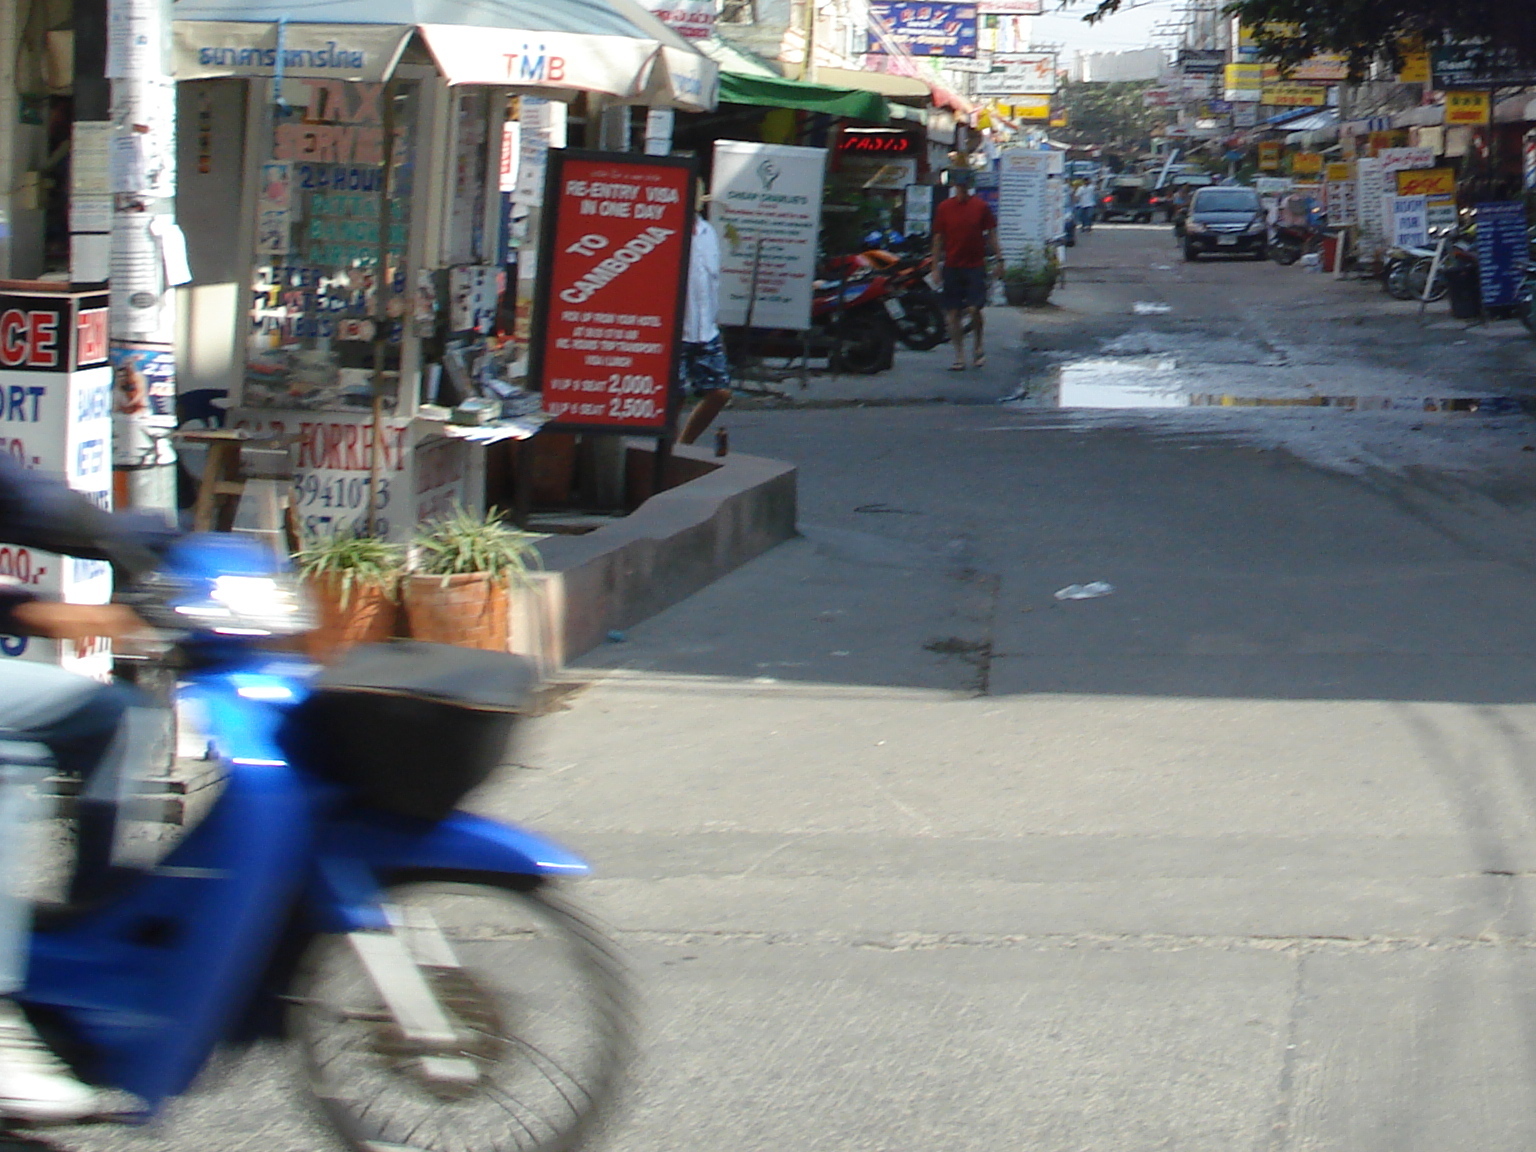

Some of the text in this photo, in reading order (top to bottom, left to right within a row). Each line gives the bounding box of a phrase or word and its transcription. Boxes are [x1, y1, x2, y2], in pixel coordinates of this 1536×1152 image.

[502, 44, 547, 81] TMB
[565, 179, 680, 204] RE-ENTRY VISA
[579, 199, 667, 221] IN ONE DAY
[564, 233, 609, 258] TO
[559, 225, 677, 304] CAMBODIA
[0, 307, 59, 368] CE
